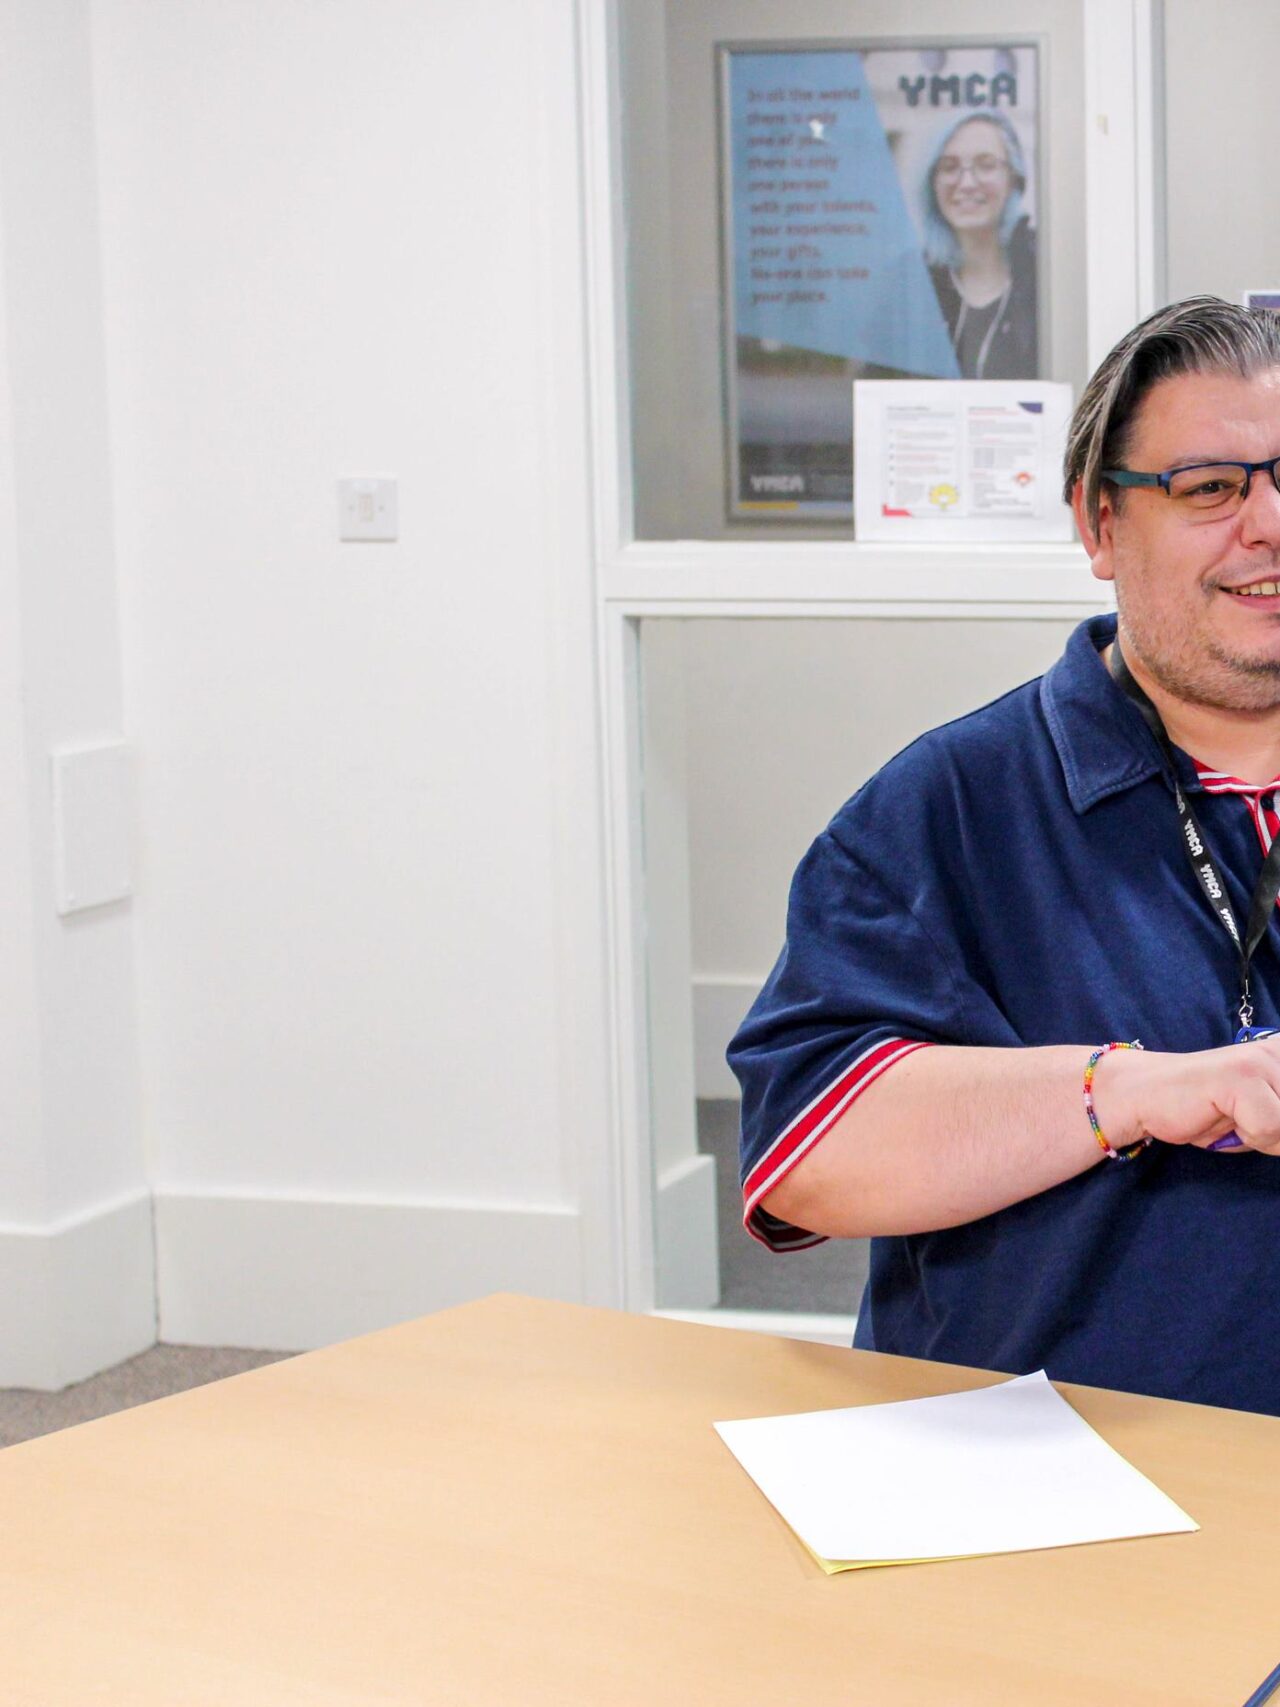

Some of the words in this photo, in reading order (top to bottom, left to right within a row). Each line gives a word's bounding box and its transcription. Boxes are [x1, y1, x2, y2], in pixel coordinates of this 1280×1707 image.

[789, 88, 813, 101] the
[819, 88, 860, 102] world
[898, 72, 1018, 107] YMCA
[747, 112, 786, 126] there
[747, 135, 775, 147] one
[747, 157, 786, 170] there
[808, 156, 839, 172] only
[748, 181, 775, 193] one
[780, 180, 830, 195] person
[750, 200, 780, 214] with
[785, 203, 817, 217] your
[750, 225, 781, 239] your
[750, 247, 781, 262] your
[751, 291, 783, 306] your
[1184, 818, 1203, 857] YMCA
[1200, 863, 1222, 899] YMCA
